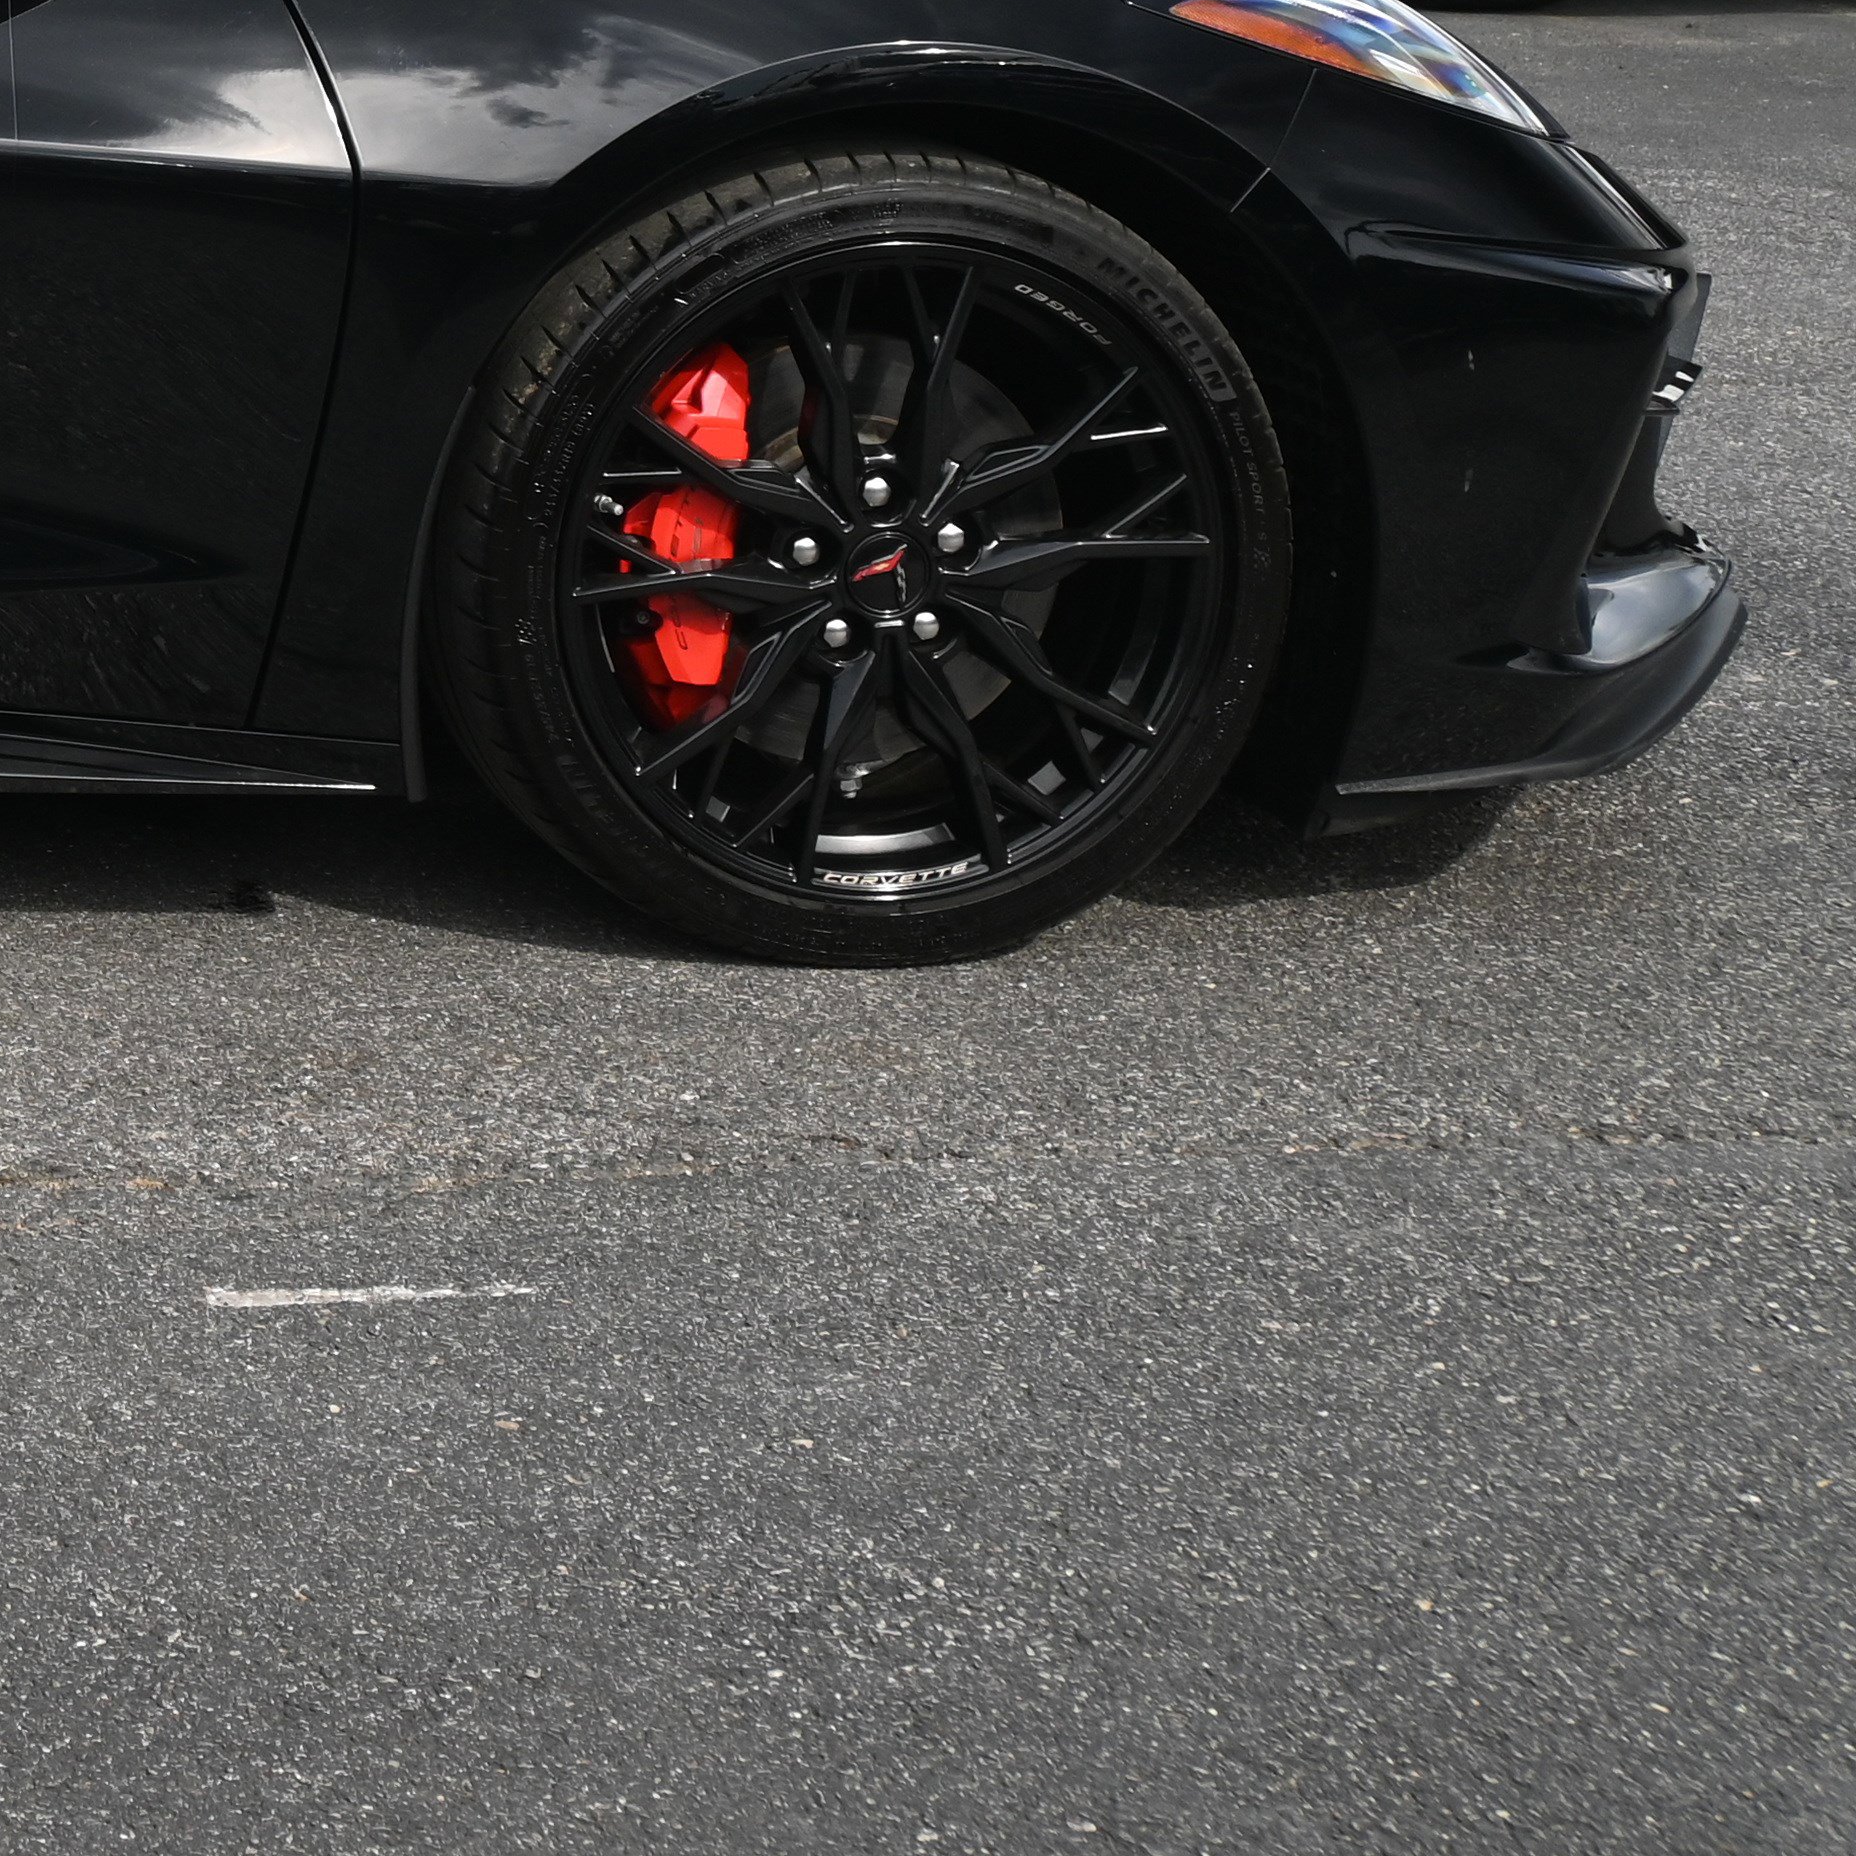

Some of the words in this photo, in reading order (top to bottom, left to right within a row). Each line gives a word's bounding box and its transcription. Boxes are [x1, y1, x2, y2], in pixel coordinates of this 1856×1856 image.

[1014, 284, 1112, 345] FORGED
[1095, 256, 1229, 394] MICHELIN
[1229, 410, 1254, 462] PILOT
[1246, 461, 1265, 513] SPORT
[823, 861, 969, 886] CORVETTE
